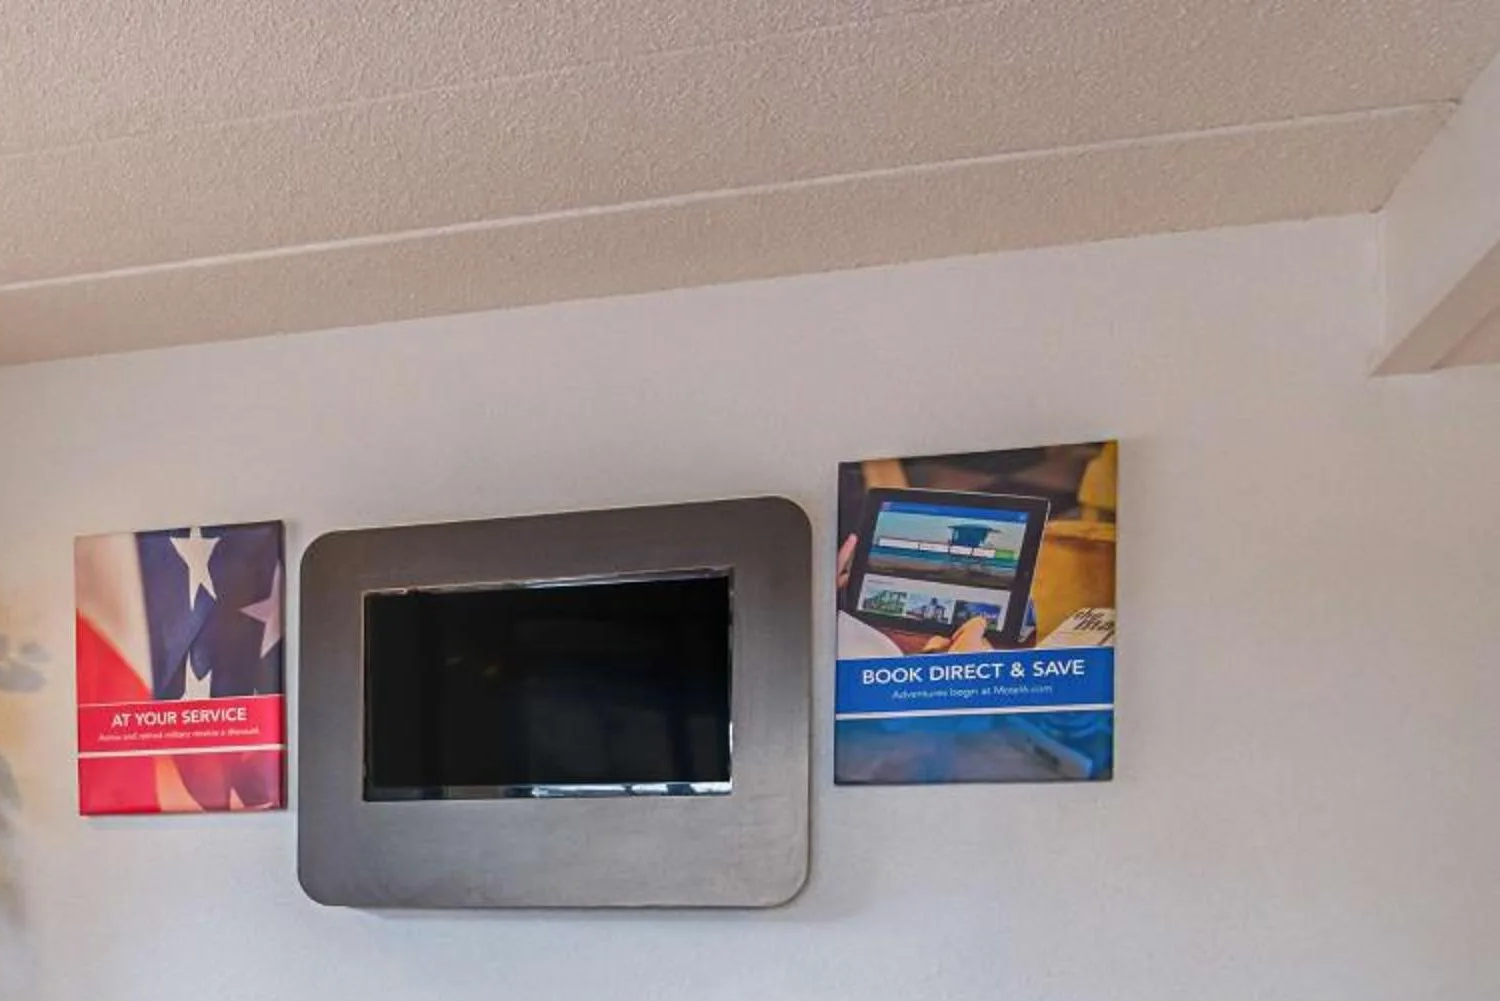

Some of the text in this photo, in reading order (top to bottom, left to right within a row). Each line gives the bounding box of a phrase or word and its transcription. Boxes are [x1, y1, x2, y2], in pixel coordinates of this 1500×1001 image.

[862, 659, 1085, 685] BOOK DIRECT & SAVE
[111, 706, 247, 728] AT YOUR SERVICE
